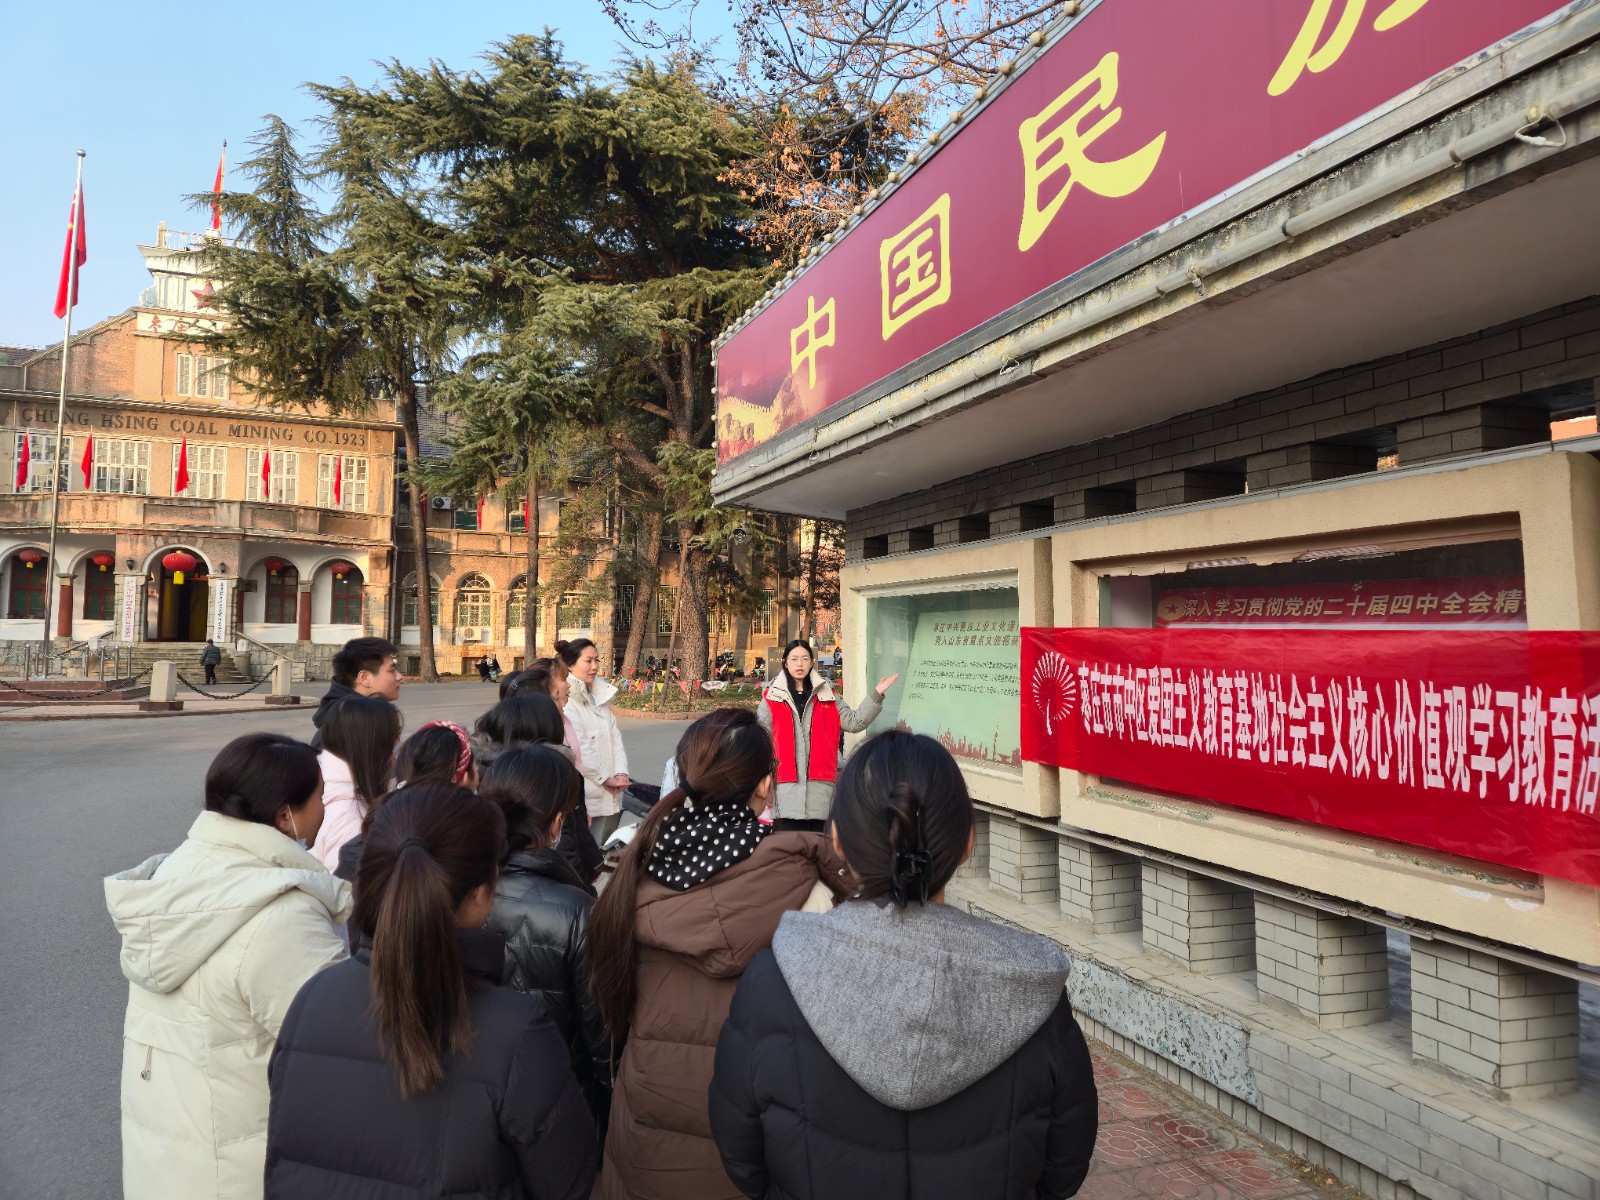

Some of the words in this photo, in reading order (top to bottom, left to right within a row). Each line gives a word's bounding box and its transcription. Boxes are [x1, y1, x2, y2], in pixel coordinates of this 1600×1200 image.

[22, 407, 90, 426] CHUNG
[101, 413, 159, 431] HSING
[169, 418, 218, 435] COAL
[228, 423, 293, 441] MINING
[1180, 588, 1526, 618] 深入学习贯彻党的二十届四中全会精
[1077, 660, 1600, 813] 枣庄市市中区爱国主义教育基地社会主义核心价值观学习教育活
